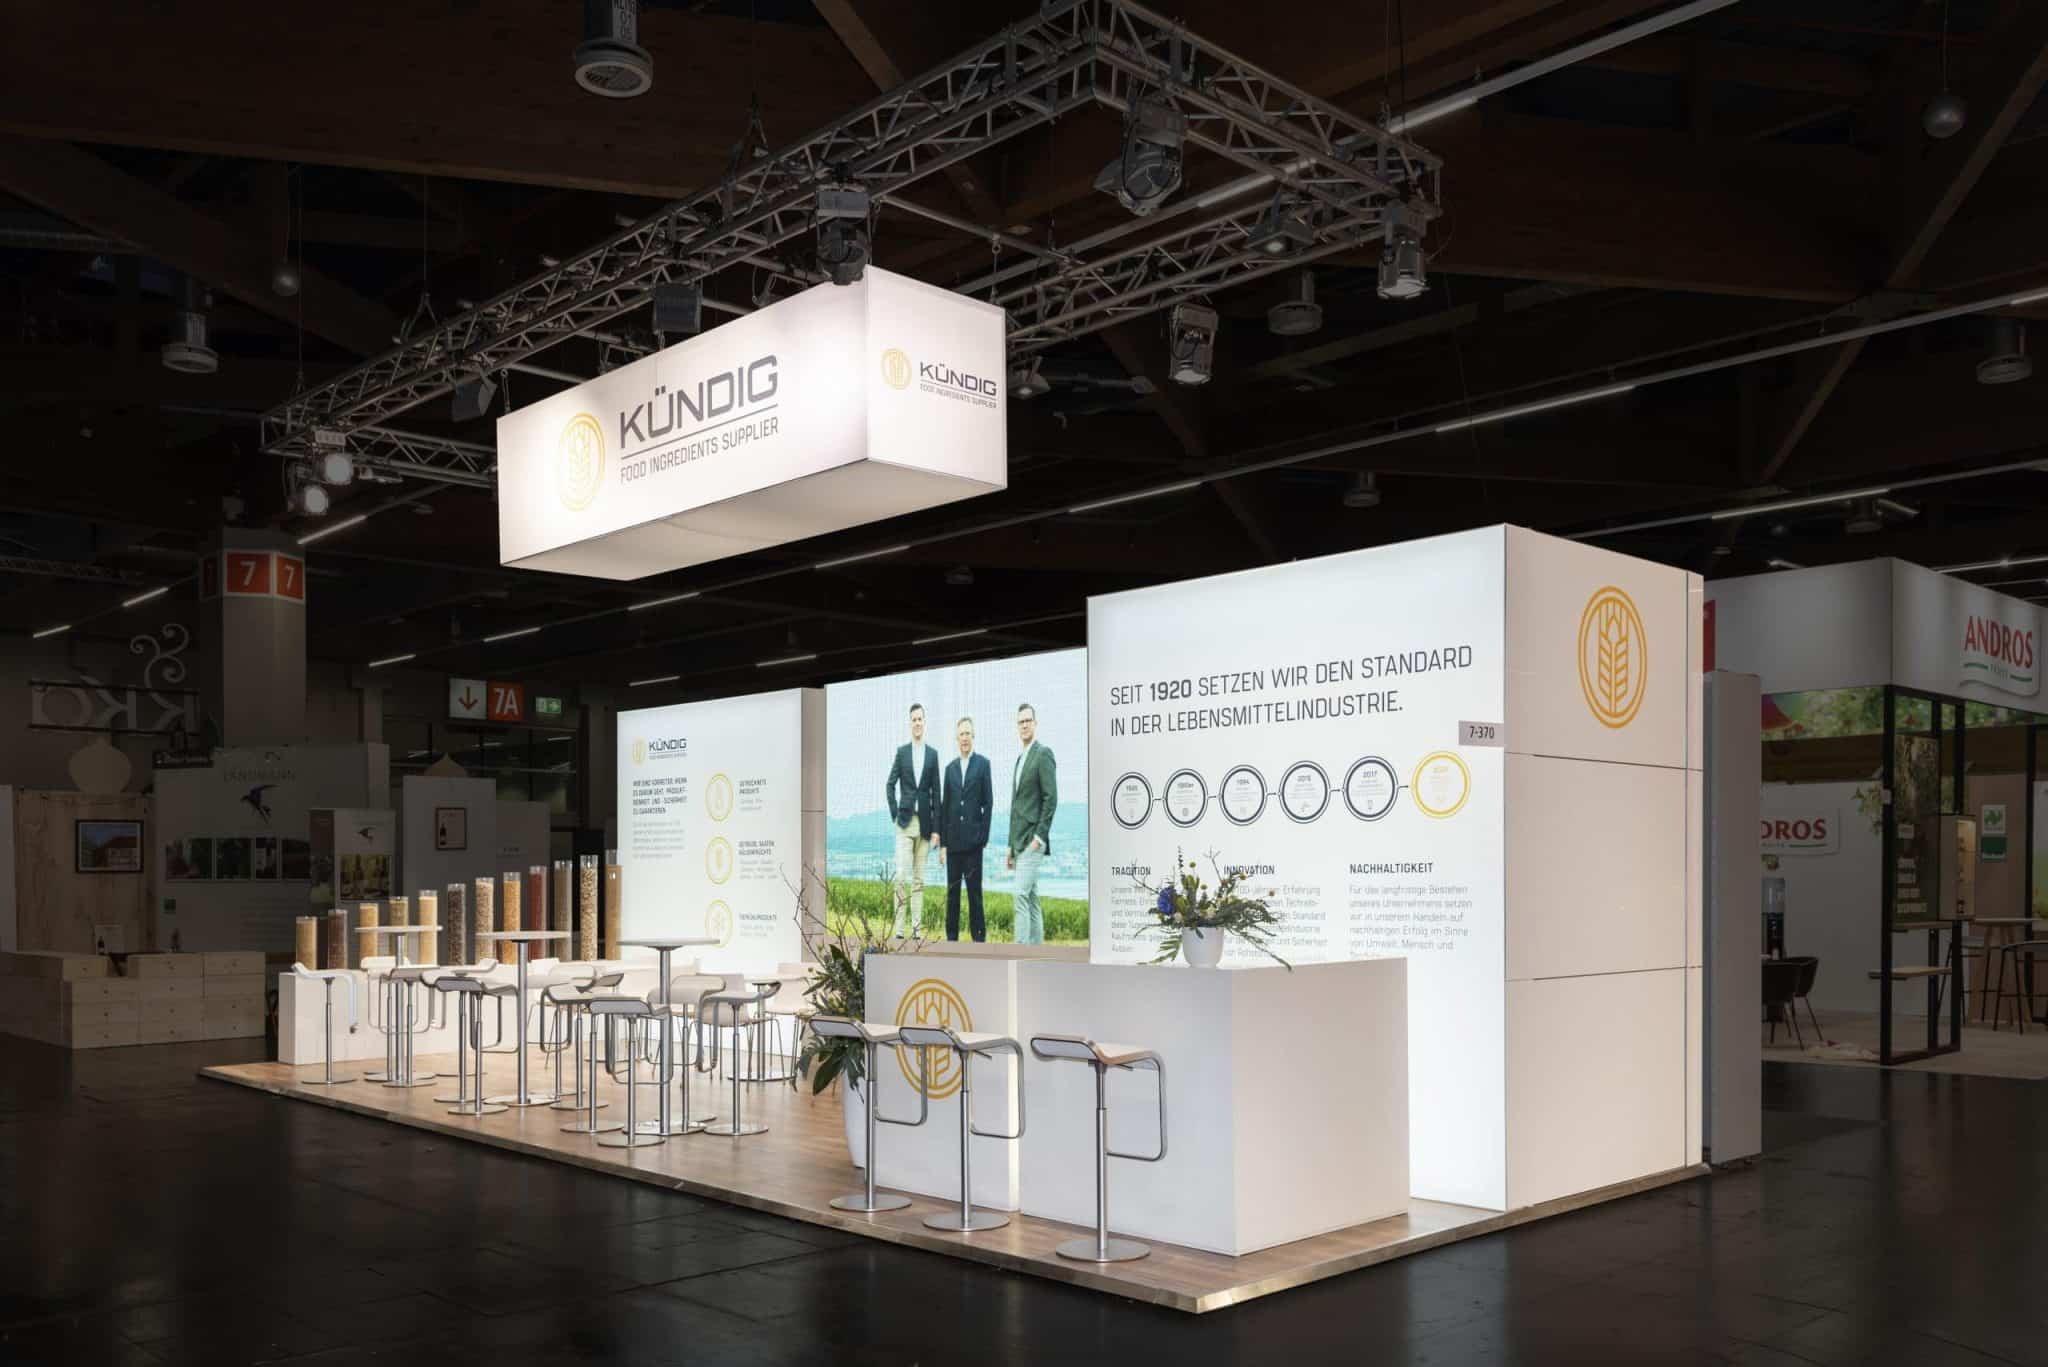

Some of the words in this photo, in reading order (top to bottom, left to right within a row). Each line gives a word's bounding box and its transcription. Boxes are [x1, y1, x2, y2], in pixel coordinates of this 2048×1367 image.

[920, 361, 997, 396] KÜNDIG
[620, 355, 779, 449] KÜNDIG
[620, 461, 647, 483] FOOD
[649, 437, 718, 475] INGREDIENTS
[722, 417, 779, 451] SUPPLIER
[240, 559, 256, 587] 7
[285, 564, 295, 591] 7
[1964, 615, 2033, 668] ANDROS
[1111, 685, 1144, 706] SEIT
[1149, 679, 1192, 702] 1920
[1198, 669, 1264, 697] SETZEN
[1271, 664, 1308, 689] WIR
[1315, 659, 1354, 684] DEN
[1361, 645, 1473, 679] STANDARD
[493, 687, 520, 716] 7A
[1111, 717, 1126, 737] IN
[1131, 713, 1162, 735] DER
[1168, 690, 1404, 732] LEBENSMITTELINDUSTRIE.
[649, 738, 687, 752] KÜNDIG
[1469, 726, 1495, 740] 7-370
[1112, 866, 1151, 876] TRADITION
[1224, 865, 1275, 875] INNOVATION
[1349, 862, 1433, 875] NACHHALTIGKEIT
[1403, 925, 1428, 938] Erfolg
